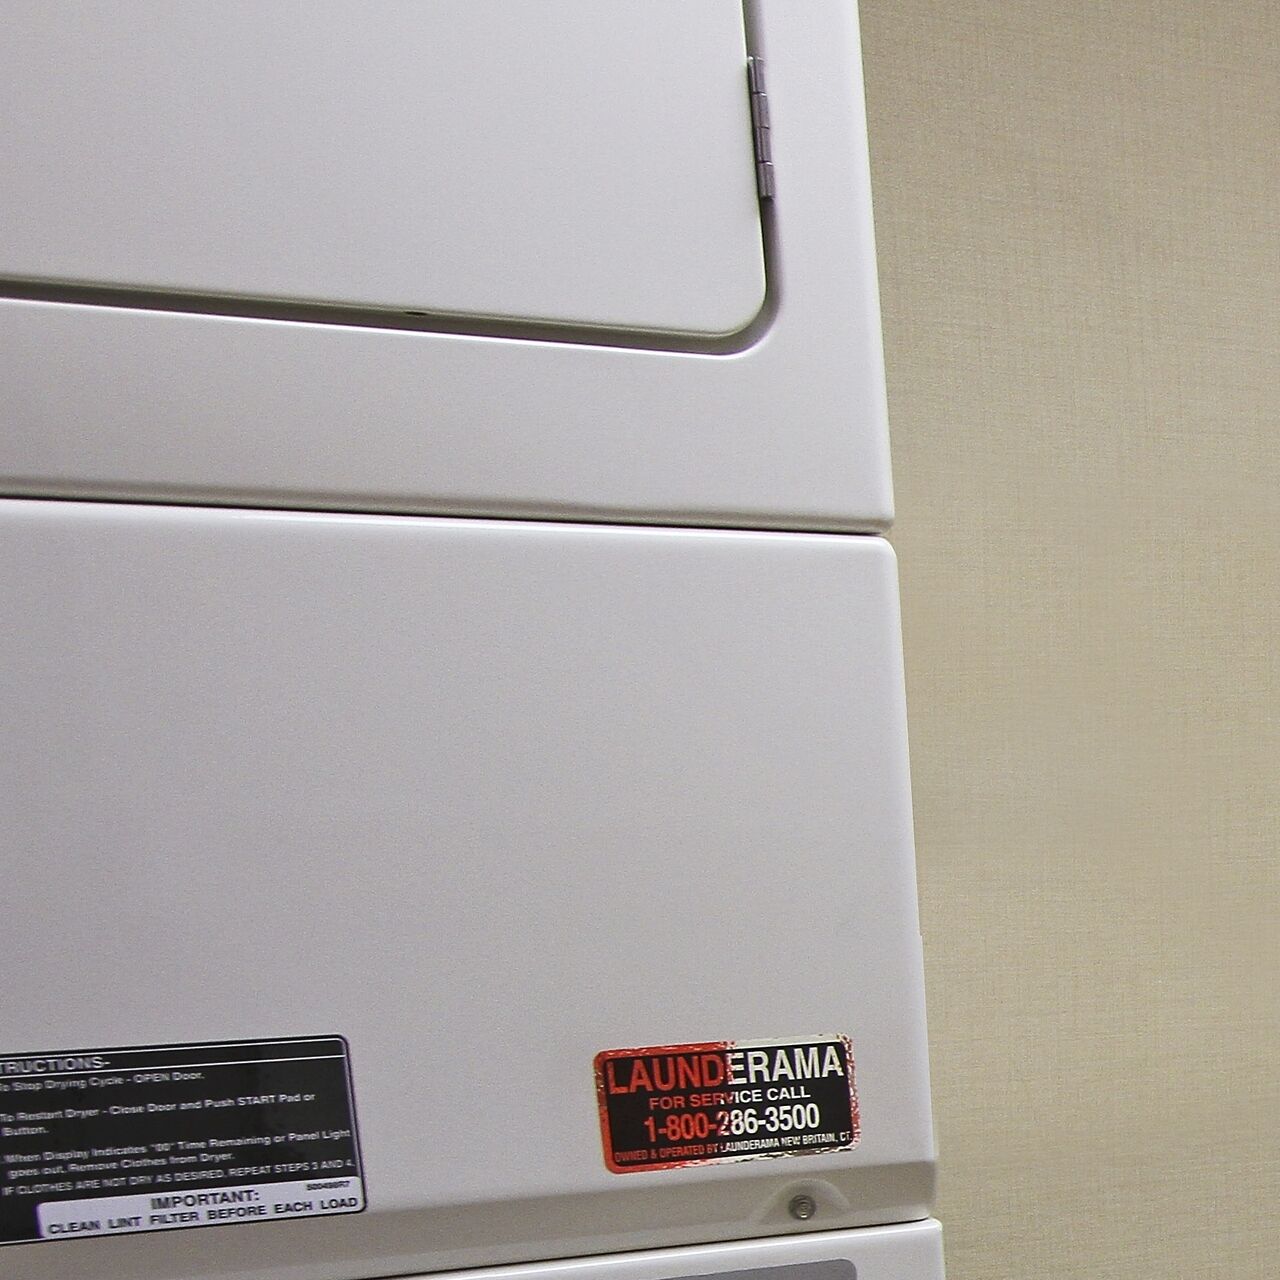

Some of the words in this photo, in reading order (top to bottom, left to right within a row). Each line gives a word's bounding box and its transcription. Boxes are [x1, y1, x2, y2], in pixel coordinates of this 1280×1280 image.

[12, 1082, 43, 1092] Stop
[44, 1079, 87, 1090] Drying
[88, 1077, 124, 1088] Cycle
[132, 1073, 170, 1084] OPEN
[607, 1045, 844, 1095] LAUNDERAMA
[109, 1105, 145, 1116] Close
[147, 1102, 177, 1113] Door
[180, 1101, 202, 1110] and
[204, 1098, 235, 1109] Push
[237, 1095, 275, 1106] START
[278, 1093, 301, 1103] Pad
[303, 1093, 316, 1101] or
[650, 1097, 685, 1111] FOR
[689, 1089, 763, 1109] SERVICE
[766, 1086, 811, 1101] CALL
[644, 1103, 820, 1143] 1-800-286-3500
[42, 1150, 89, 1161] Display
[91, 1145, 147, 1157] Indicates
[177, 1140, 207, 1150] Time
[209, 1135, 271, 1148] Remaining
[274, 1134, 286, 1142] or
[288, 1131, 320, 1142] Panel
[322, 1129, 351, 1141] Light
[615, 1150, 648, 1163] OWNED
[661, 1145, 705, 1158] OPERATED
[706, 1143, 718, 1154] BY
[781, 1136, 801, 1147] NEW
[67, 1162, 119, 1173] Remove
[120, 1157, 168, 1169] Clothes
[169, 1154, 197, 1165] from
[3, 1186, 14, 1196] IF
[16, 1181, 73, 1194] CLOTHES
[75, 1179, 100, 1190] ARE
[102, 1176, 126, 1187] NOT
[156, 1173, 172, 1183] AS
[228, 1165, 271, 1177] REPEAT
[274, 1161, 310, 1173] STEPS
[311, 1161, 319, 1170] 3
[320, 1159, 344, 1170] AND
[151, 1189, 260, 1210] IMPORTANT:
[48, 1220, 101, 1234] CLEAN
[108, 1216, 142, 1229] LINT
[150, 1211, 199, 1226] FILTER
[207, 1204, 267, 1220] BEFORE
[274, 1201, 313, 1214] EACH
[320, 1197, 358, 1210] LOAD
